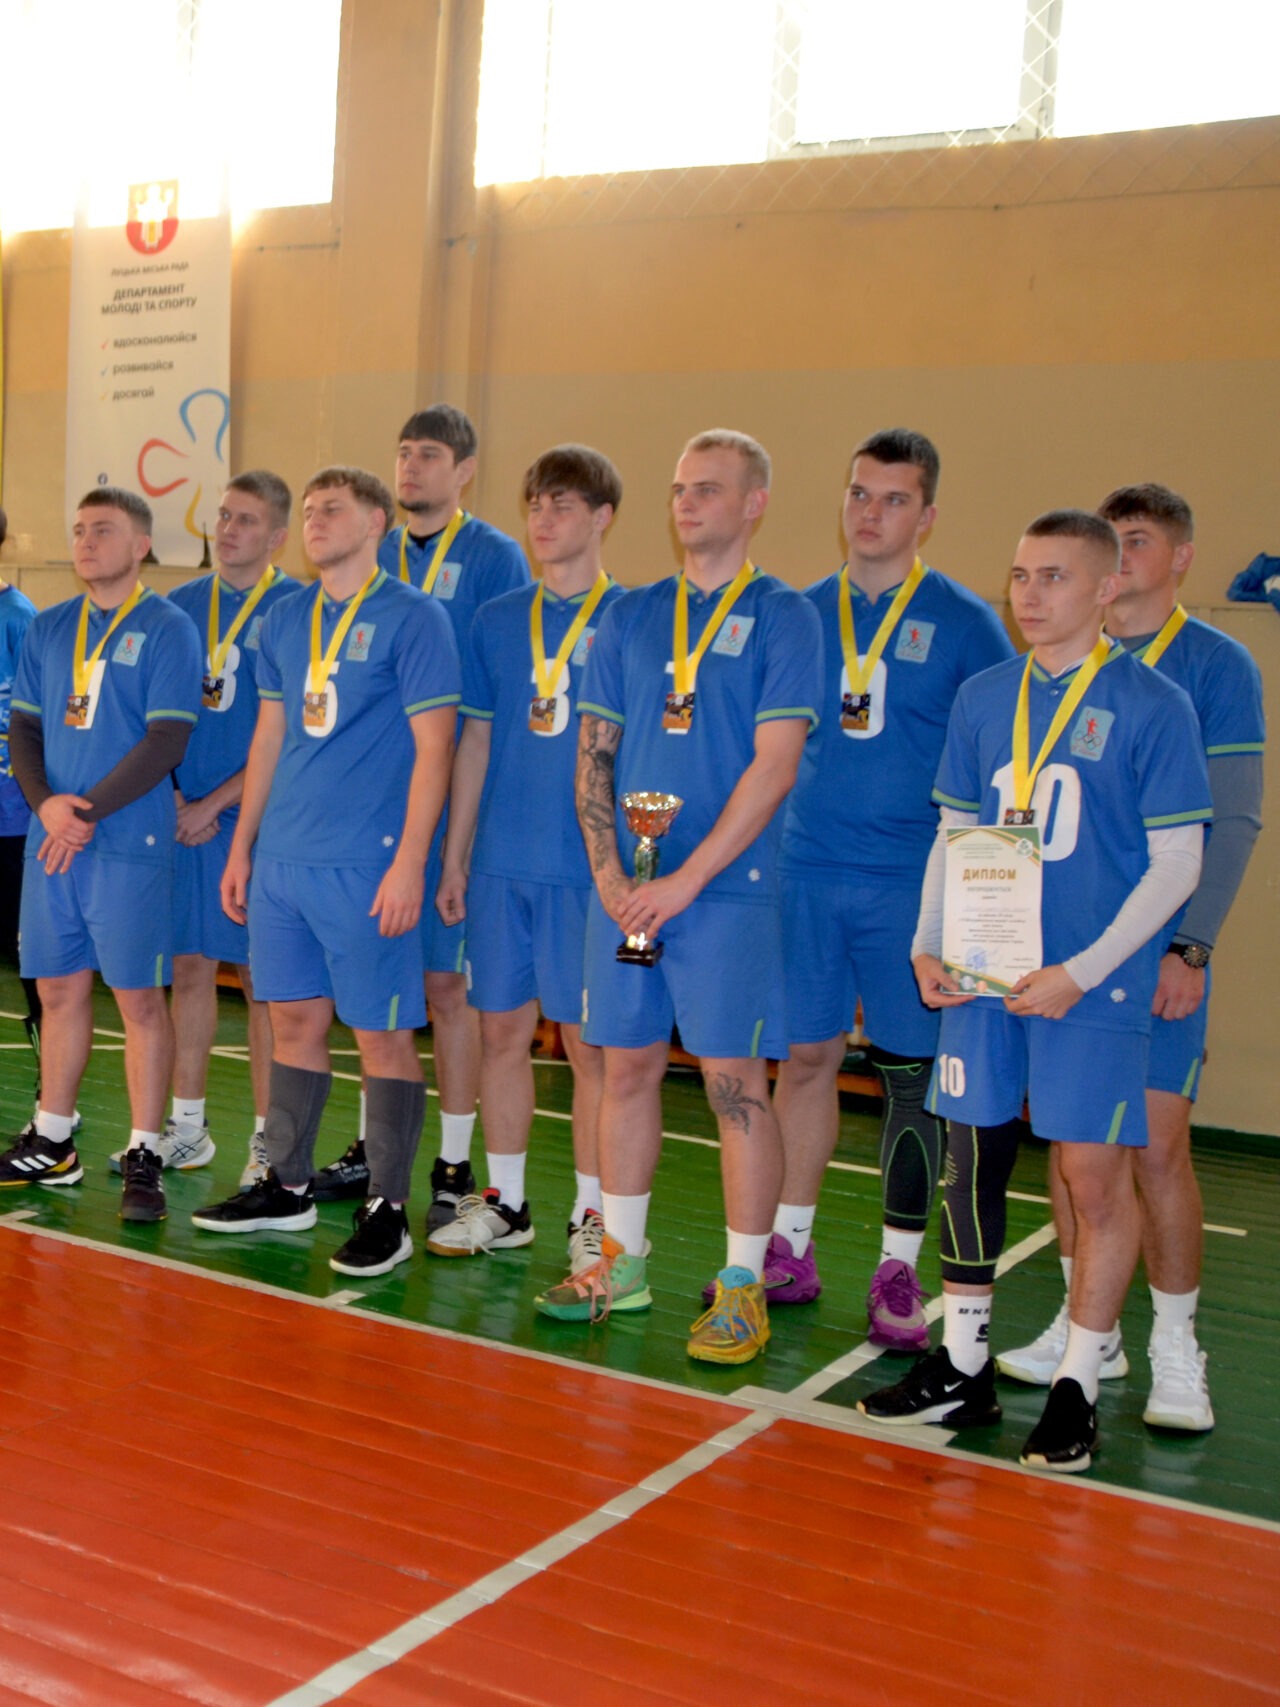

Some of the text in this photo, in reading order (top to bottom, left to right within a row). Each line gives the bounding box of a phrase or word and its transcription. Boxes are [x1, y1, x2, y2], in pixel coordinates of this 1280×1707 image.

[113, 283, 185, 301] ДЕПАРТАМЕНТ
[101, 297, 197, 315] МОЛОДІ ТА СПОРТУ
[990, 760, 1081, 862] 10
[963, 868, 1017, 881] ДИПЛОМ
[939, 1053, 966, 1098] 10
